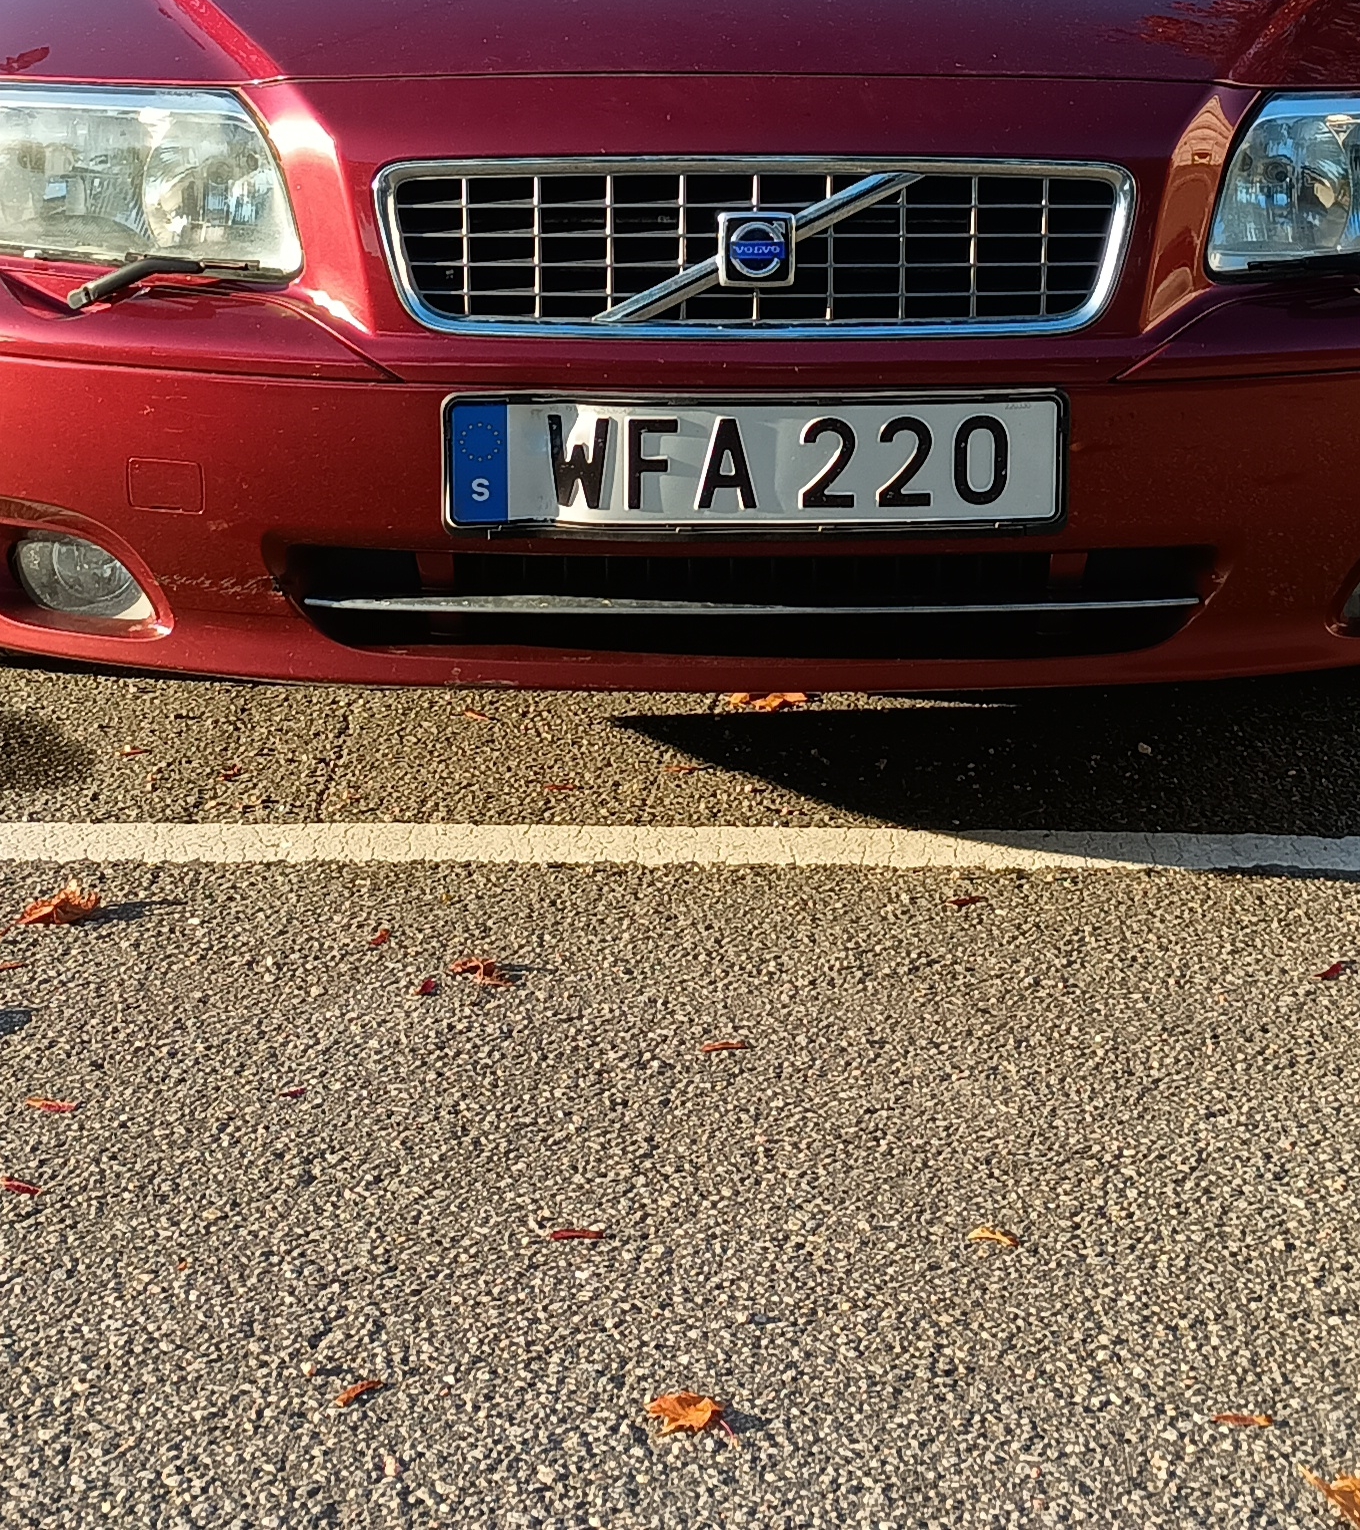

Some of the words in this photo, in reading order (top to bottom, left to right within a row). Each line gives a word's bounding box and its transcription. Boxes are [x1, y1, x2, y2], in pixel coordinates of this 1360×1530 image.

[733, 245, 780, 254] VOLVO
[471, 477, 490, 502] S
[548, 414, 757, 510] WFA
[800, 415, 1010, 508] 220
